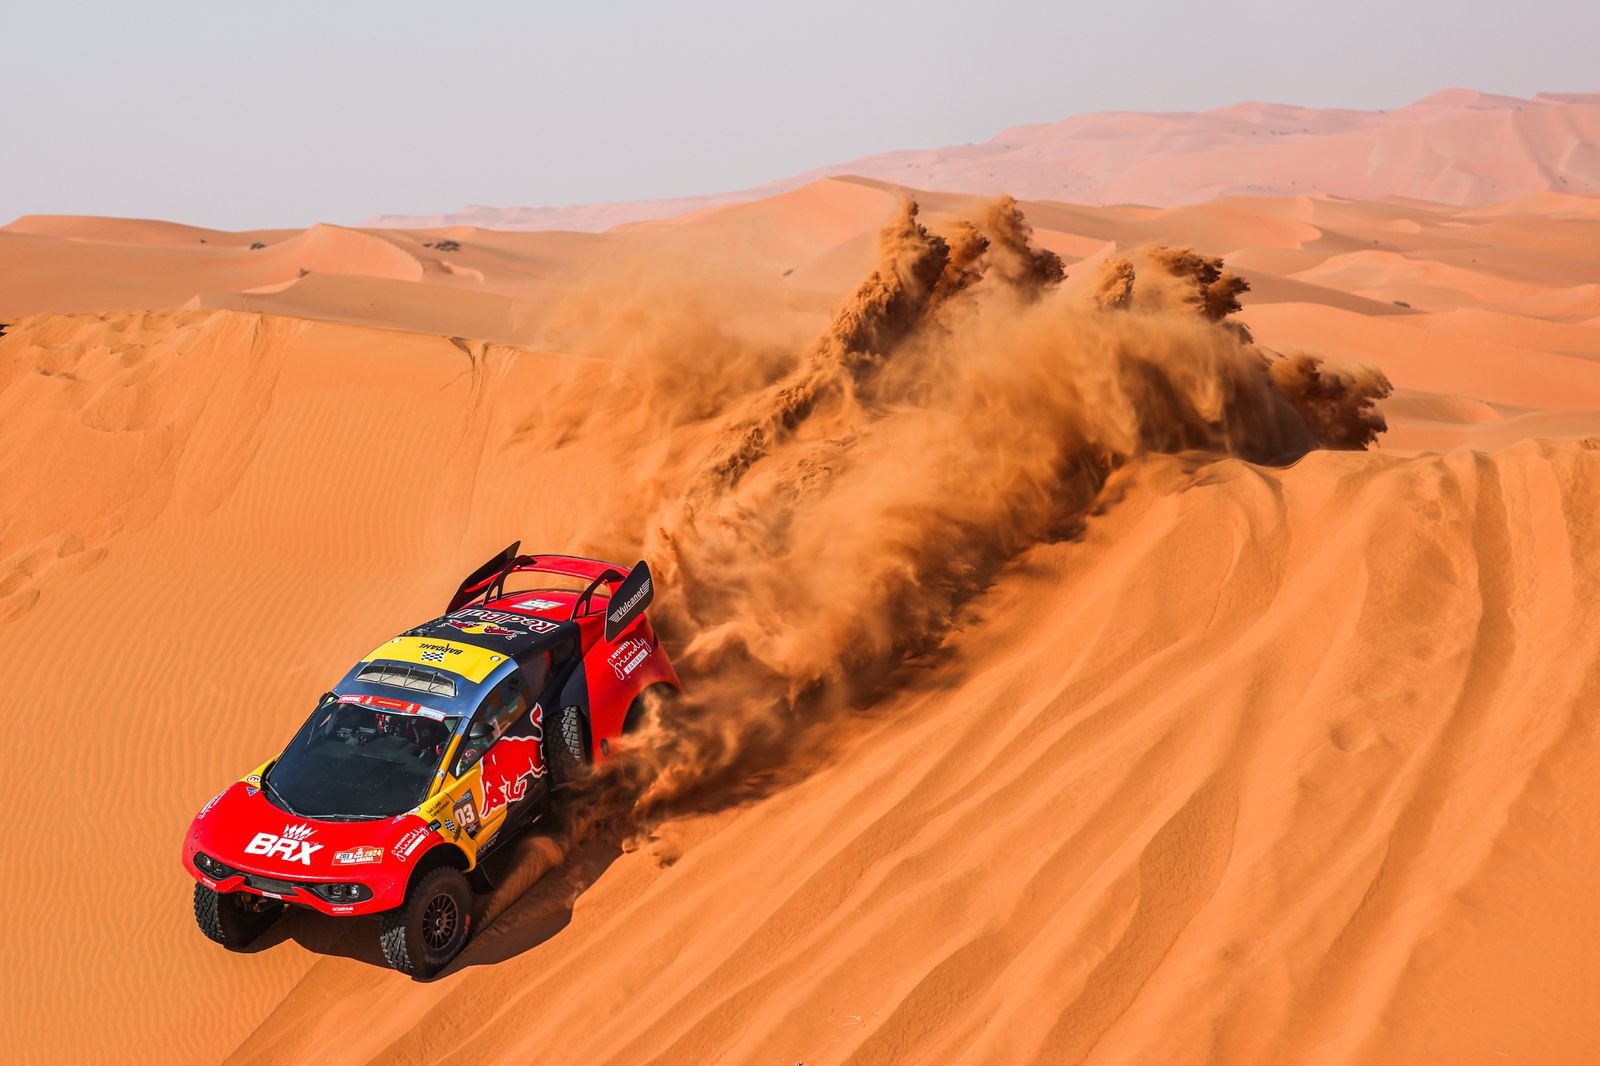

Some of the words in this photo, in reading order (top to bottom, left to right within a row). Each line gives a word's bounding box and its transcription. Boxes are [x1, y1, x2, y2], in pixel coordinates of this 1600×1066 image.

[617, 585, 644, 616] Vulcanet
[419, 642, 464, 655] BARDAHL
[607, 637, 652, 681] friendly
[611, 640, 631, 659] BUSINESS
[454, 803, 475, 828] 03
[244, 832, 324, 866] BRX
[364, 849, 382, 857] 2024
